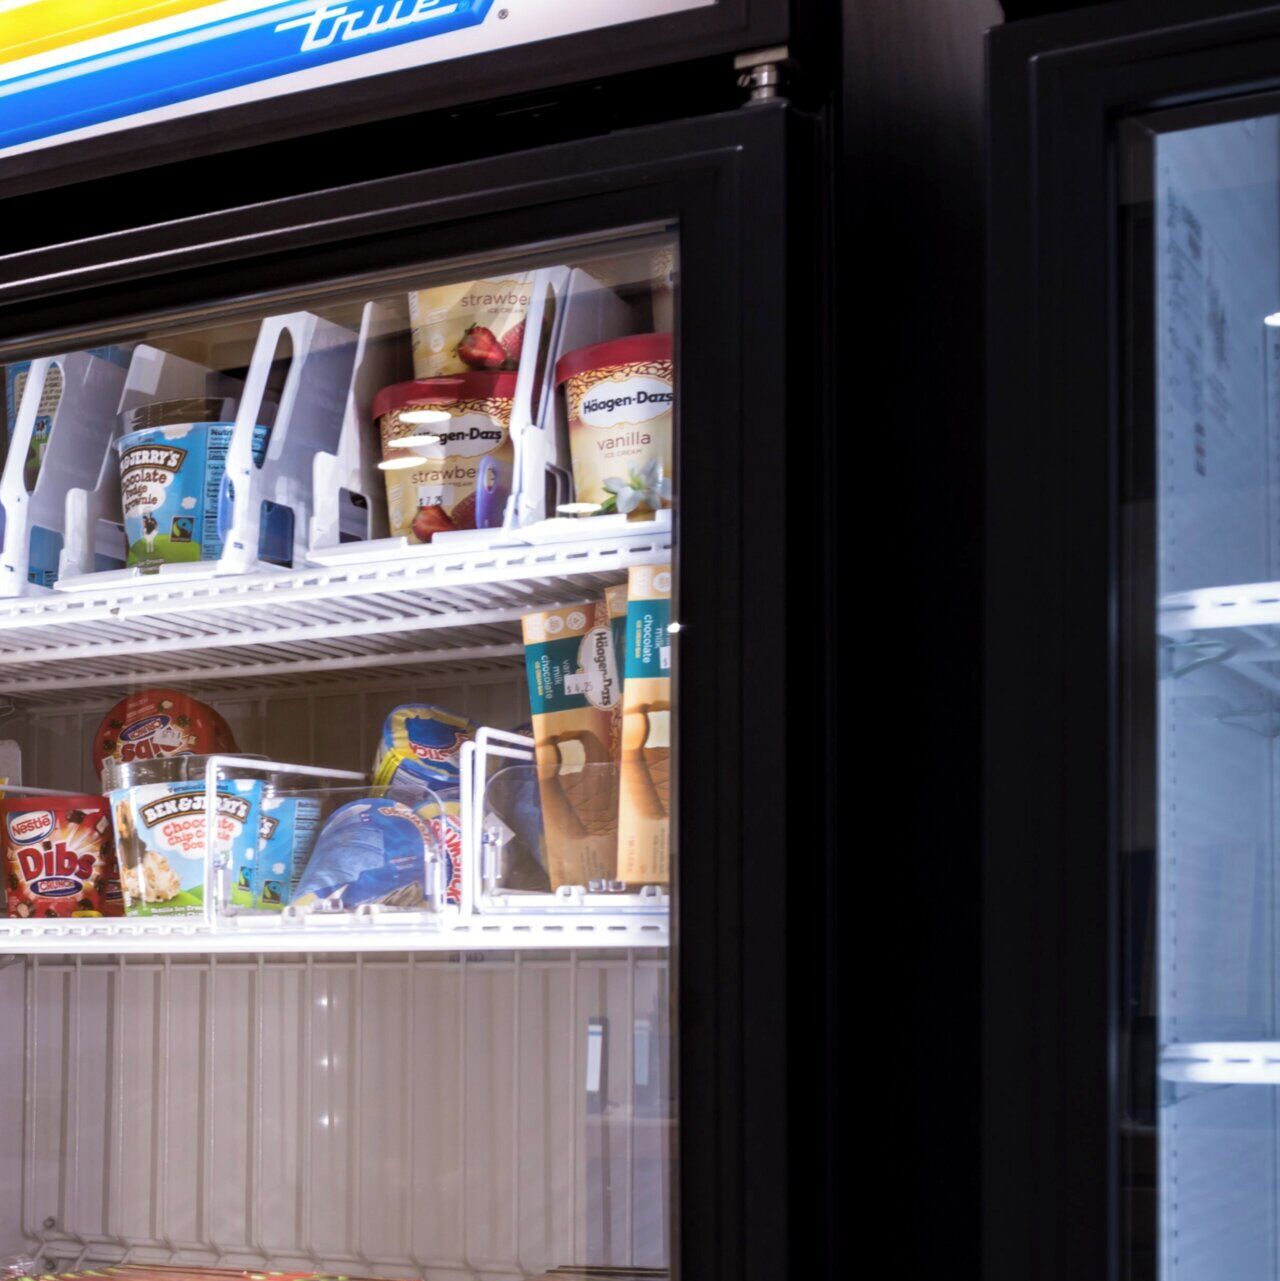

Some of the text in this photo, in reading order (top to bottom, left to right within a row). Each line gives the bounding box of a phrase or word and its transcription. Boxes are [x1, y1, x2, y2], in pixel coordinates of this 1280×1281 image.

[461, 292, 531, 307] strawbe
[597, 432, 652, 451] vanilla
[411, 466, 476, 484] strawbe
[643, 614, 653, 663] chocolate
[541, 655, 554, 699] chocolate
[12, 815, 51, 837] Nestlé
[17, 842, 96, 882] Dibs
